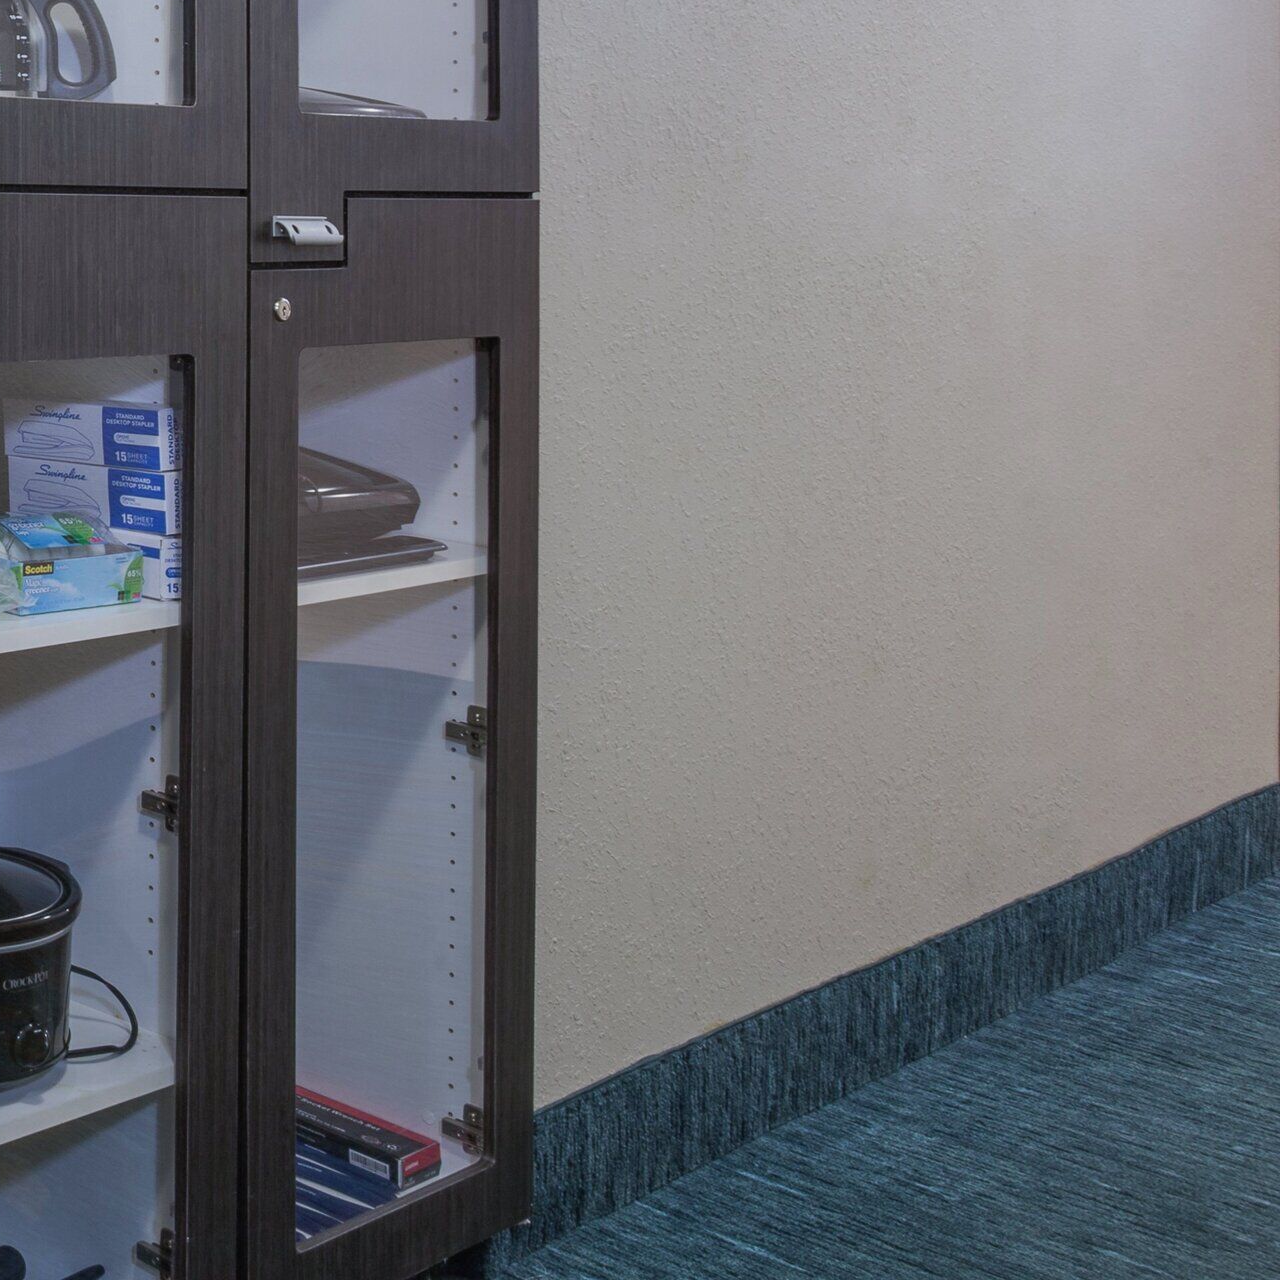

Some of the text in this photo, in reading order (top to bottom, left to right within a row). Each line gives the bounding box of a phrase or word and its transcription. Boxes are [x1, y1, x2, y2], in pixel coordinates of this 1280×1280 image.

[29, 405, 82, 422] Swingline
[105, 418, 155, 428] DESKTOP STAPLER
[166, 414, 175, 465] STANDARD
[115, 451, 148, 462] 15 SHEET
[35, 464, 87, 481] Swingline
[121, 475, 151, 484] STANDARD
[111, 480, 161, 492] DESKTOP STAPLER
[121, 513, 154, 524] 15 SHEET
[24, 564, 53, 575] Scotch
[166, 583, 180, 594] 15
